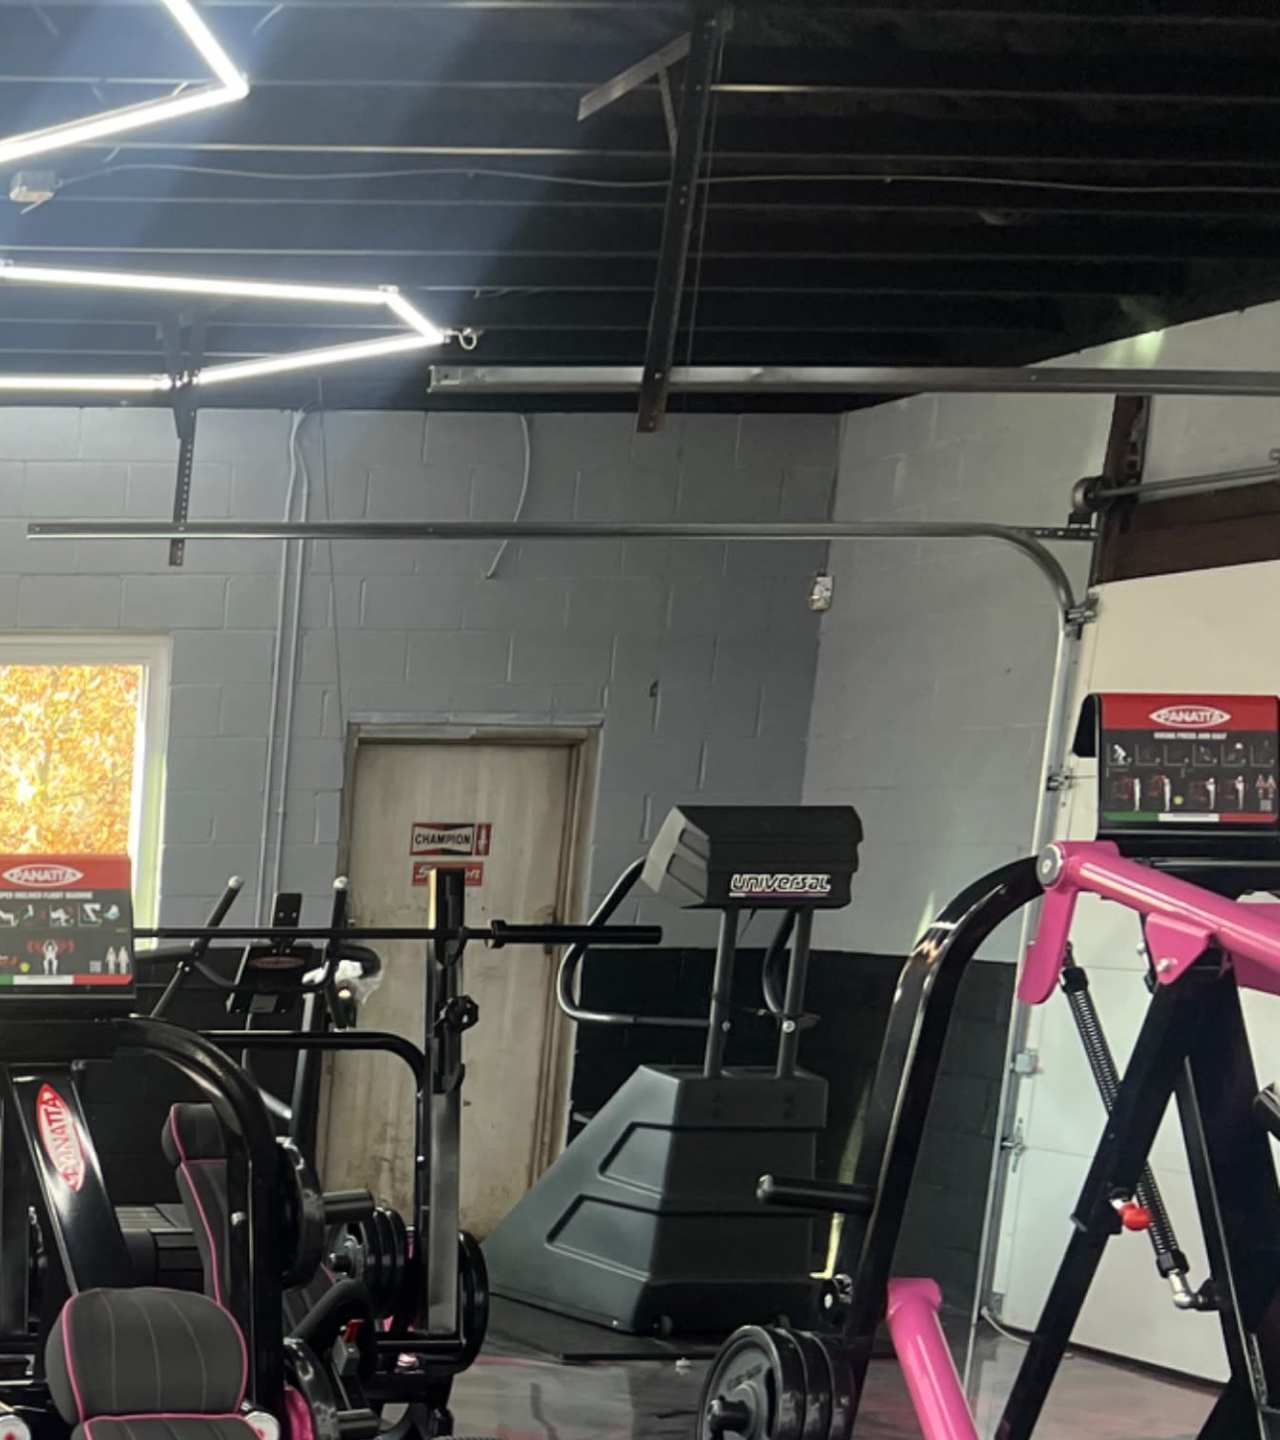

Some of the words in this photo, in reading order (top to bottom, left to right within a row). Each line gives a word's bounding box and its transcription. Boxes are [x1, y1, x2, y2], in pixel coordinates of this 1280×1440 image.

[1159, 709, 1222, 723] PANATTA
[414, 832, 471, 845] CHAMPION
[13, 867, 74, 882] PANATTA
